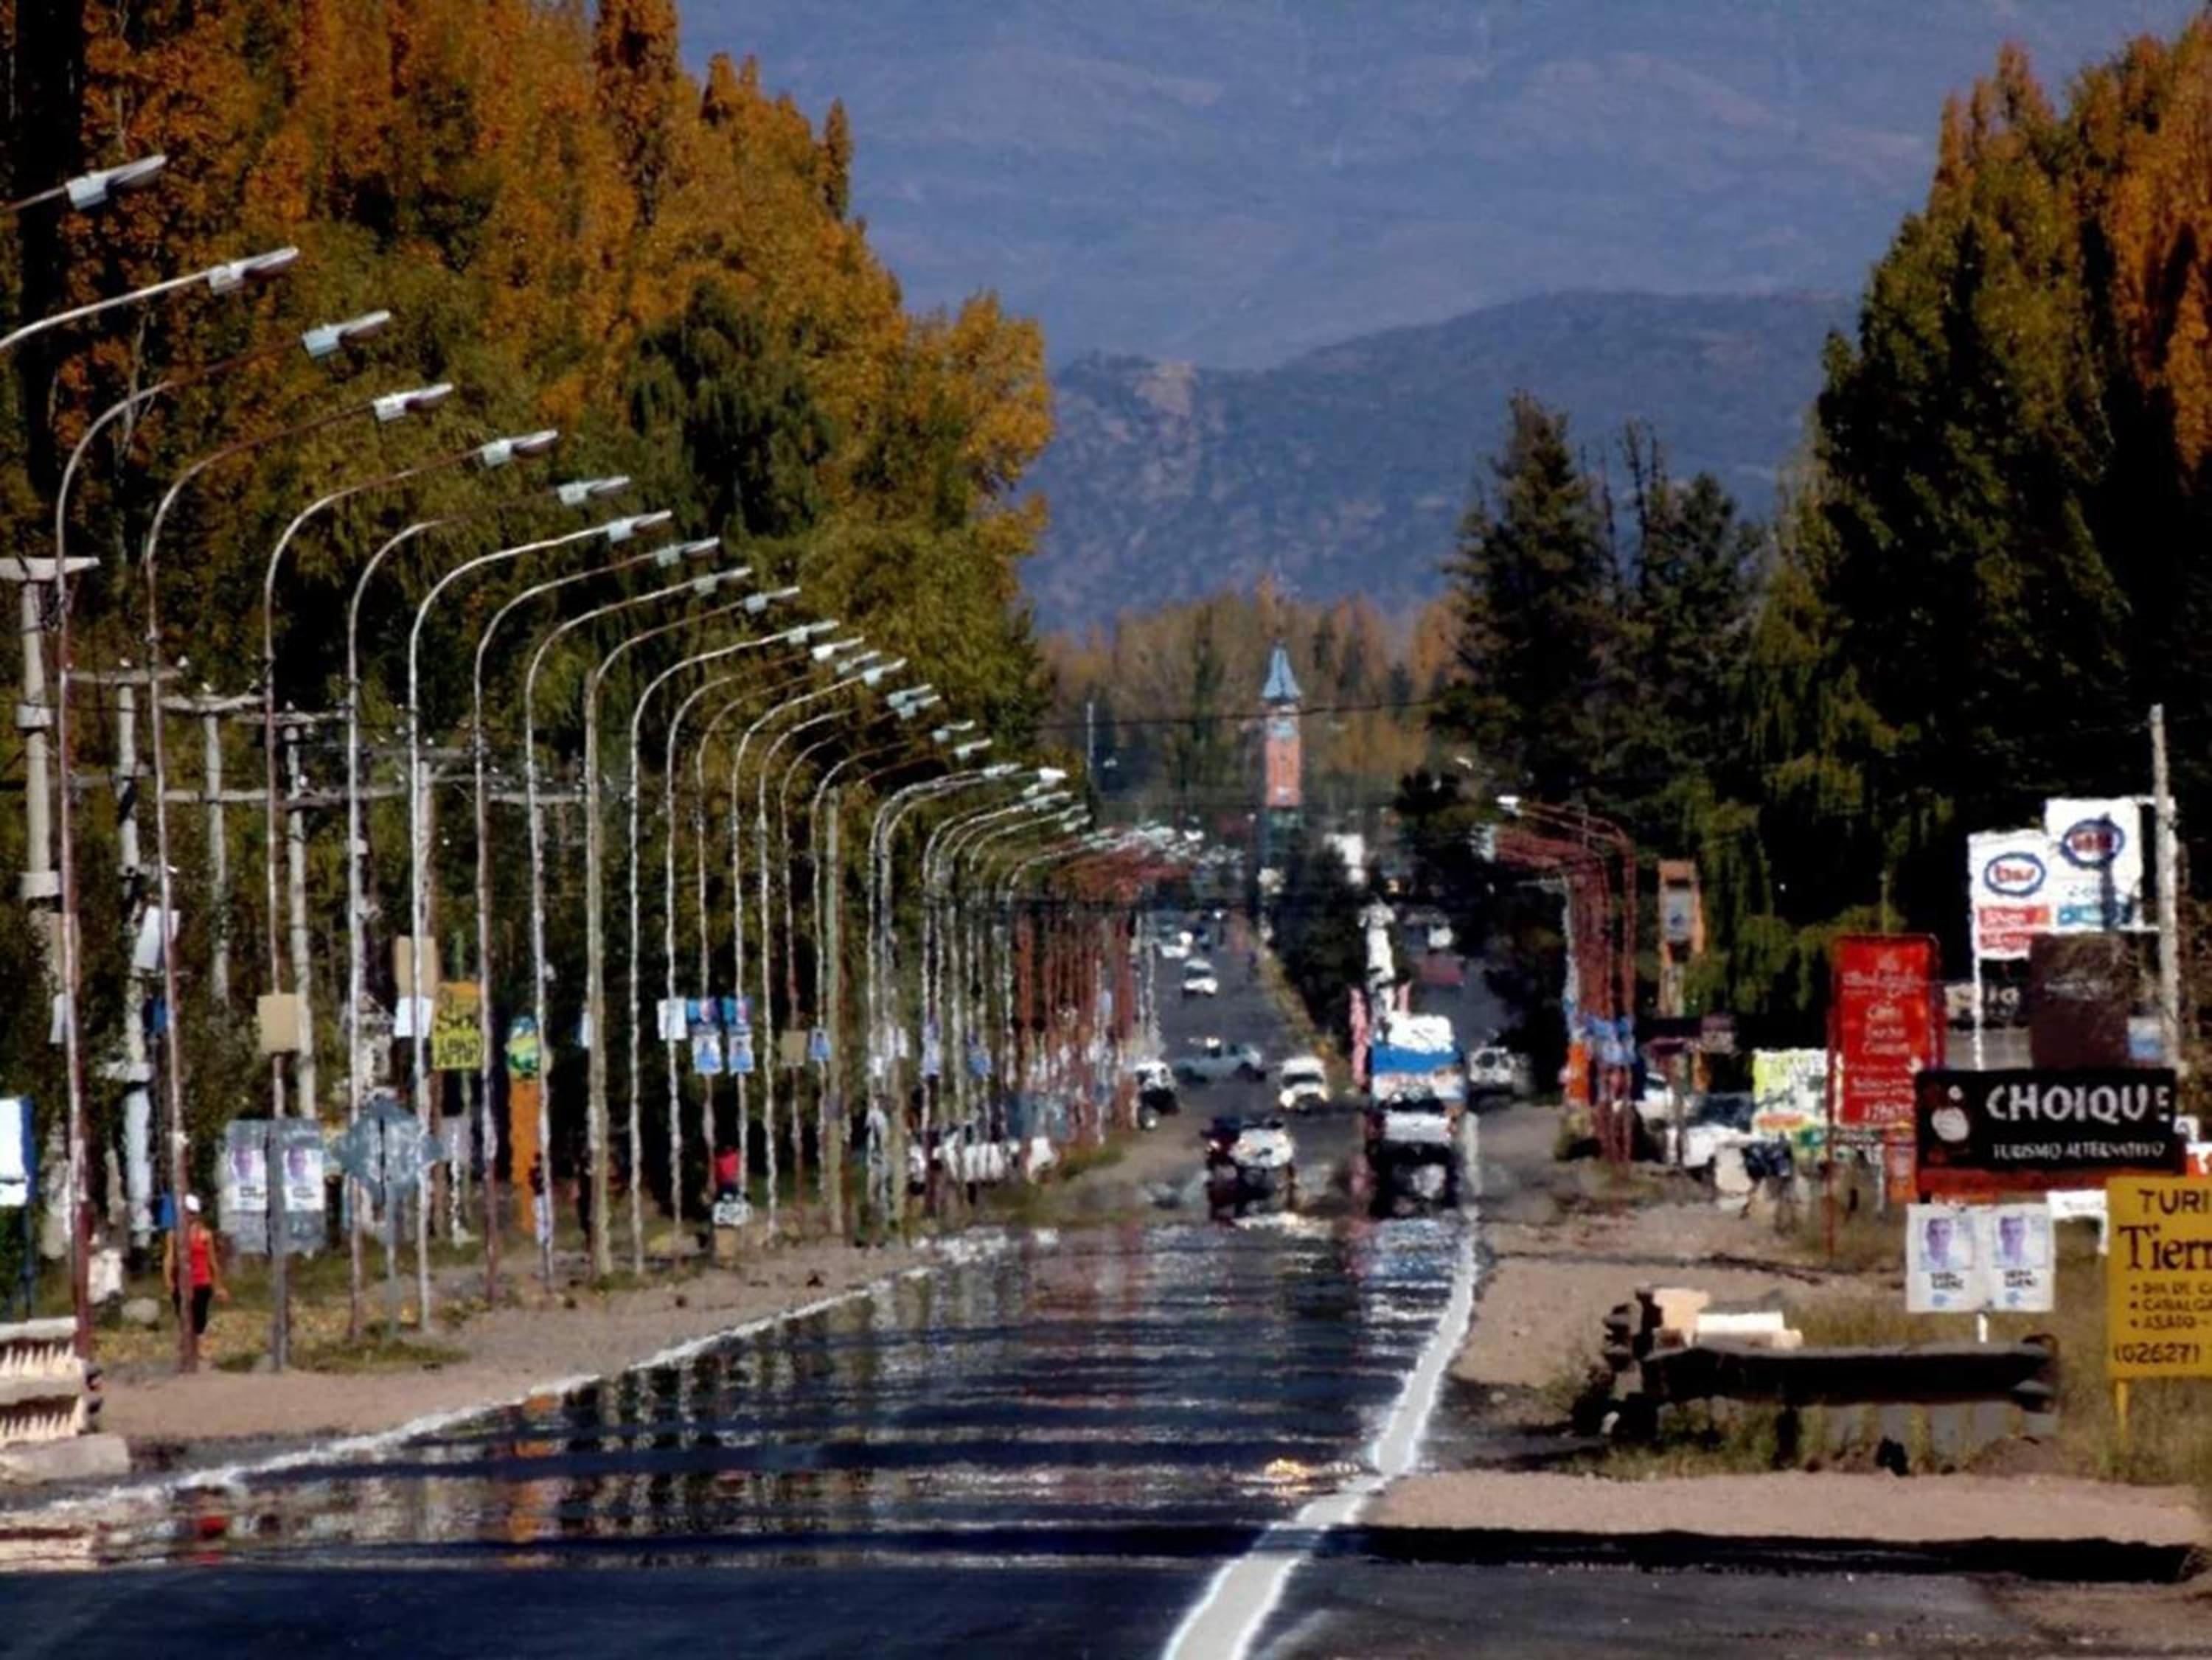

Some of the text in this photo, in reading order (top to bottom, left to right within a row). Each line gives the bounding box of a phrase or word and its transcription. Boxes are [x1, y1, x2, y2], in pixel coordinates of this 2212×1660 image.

[1986, 1083, 2170, 1125] CHOIQUE
[1992, 1142, 2166, 1160] TURISMO ALTERNATIVO
[2138, 1188, 2210, 1215] TURI
